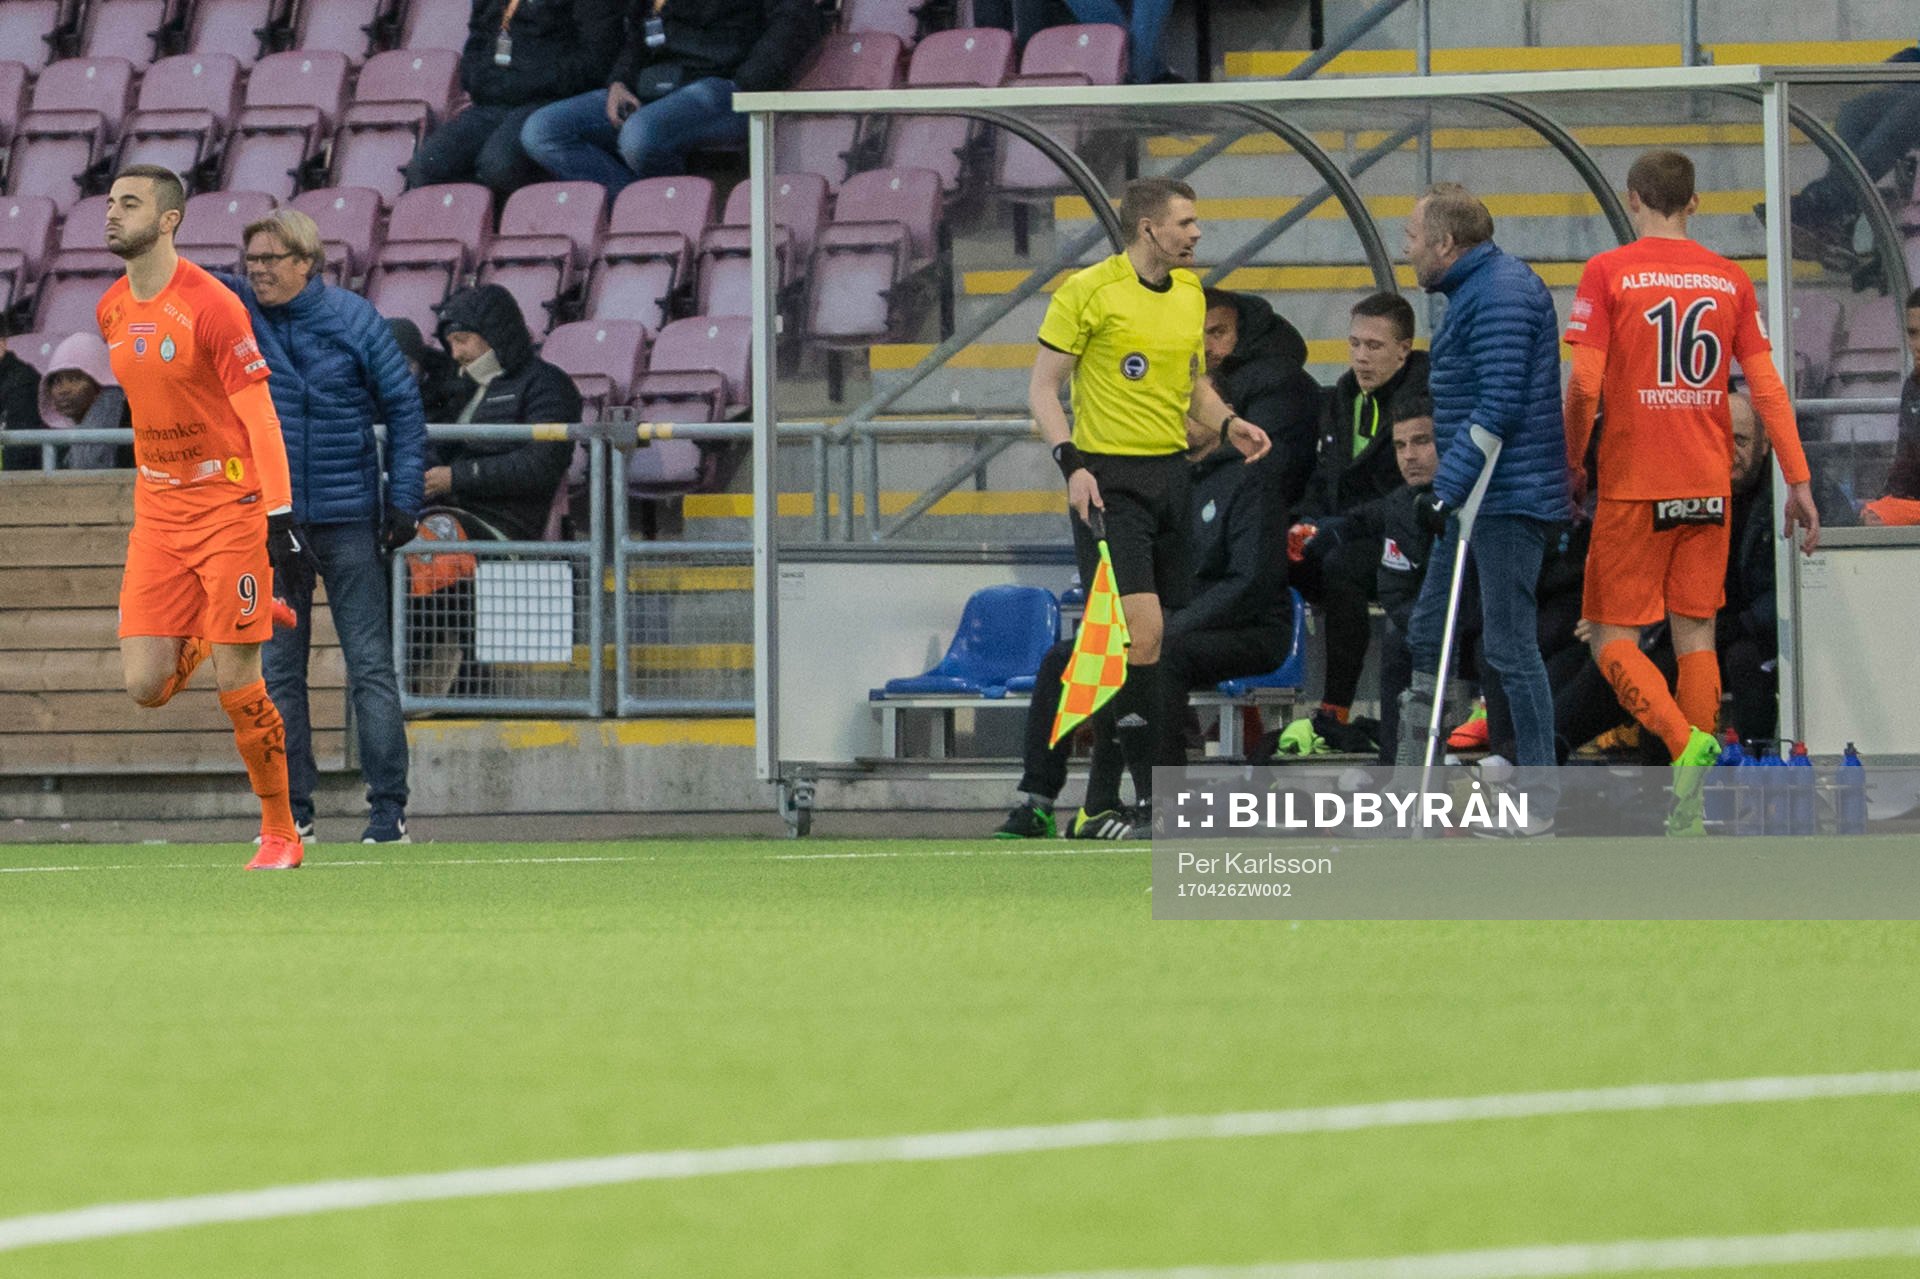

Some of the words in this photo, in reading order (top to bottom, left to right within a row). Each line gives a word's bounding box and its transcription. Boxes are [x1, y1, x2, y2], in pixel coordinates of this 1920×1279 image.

[1621, 271, 1737, 296] ALEXANDERSSON
[1643, 295, 1722, 388] 16
[237, 573, 259, 616] 9
